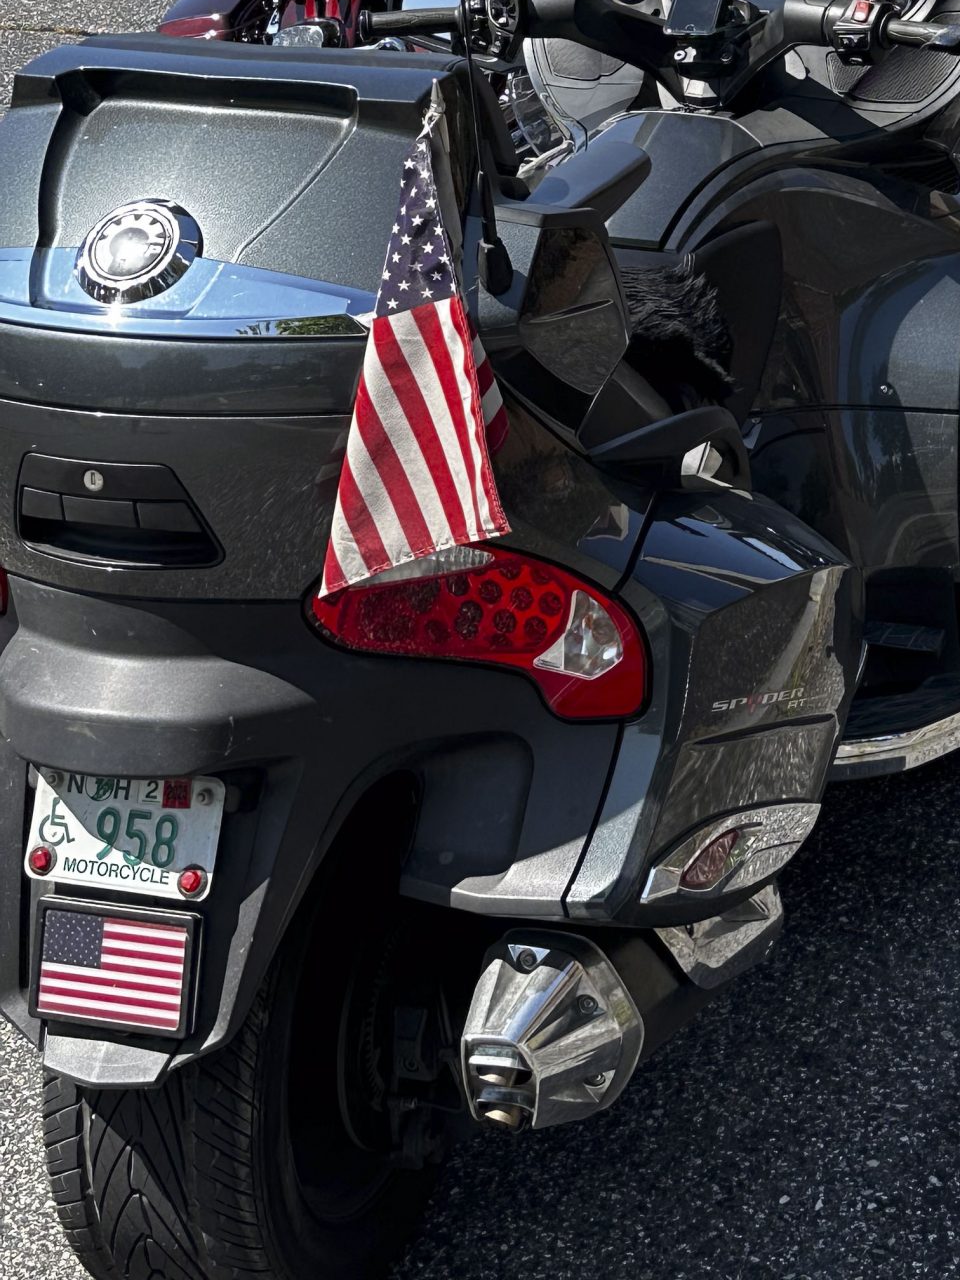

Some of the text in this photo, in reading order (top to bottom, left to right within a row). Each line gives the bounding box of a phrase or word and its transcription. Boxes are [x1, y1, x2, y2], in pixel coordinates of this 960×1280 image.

[711, 687, 805, 714] SPYDER
[145, 780, 159, 800] 2
[96, 806, 179, 869] 958
[63, 857, 170, 885] MOTORCYCLE
